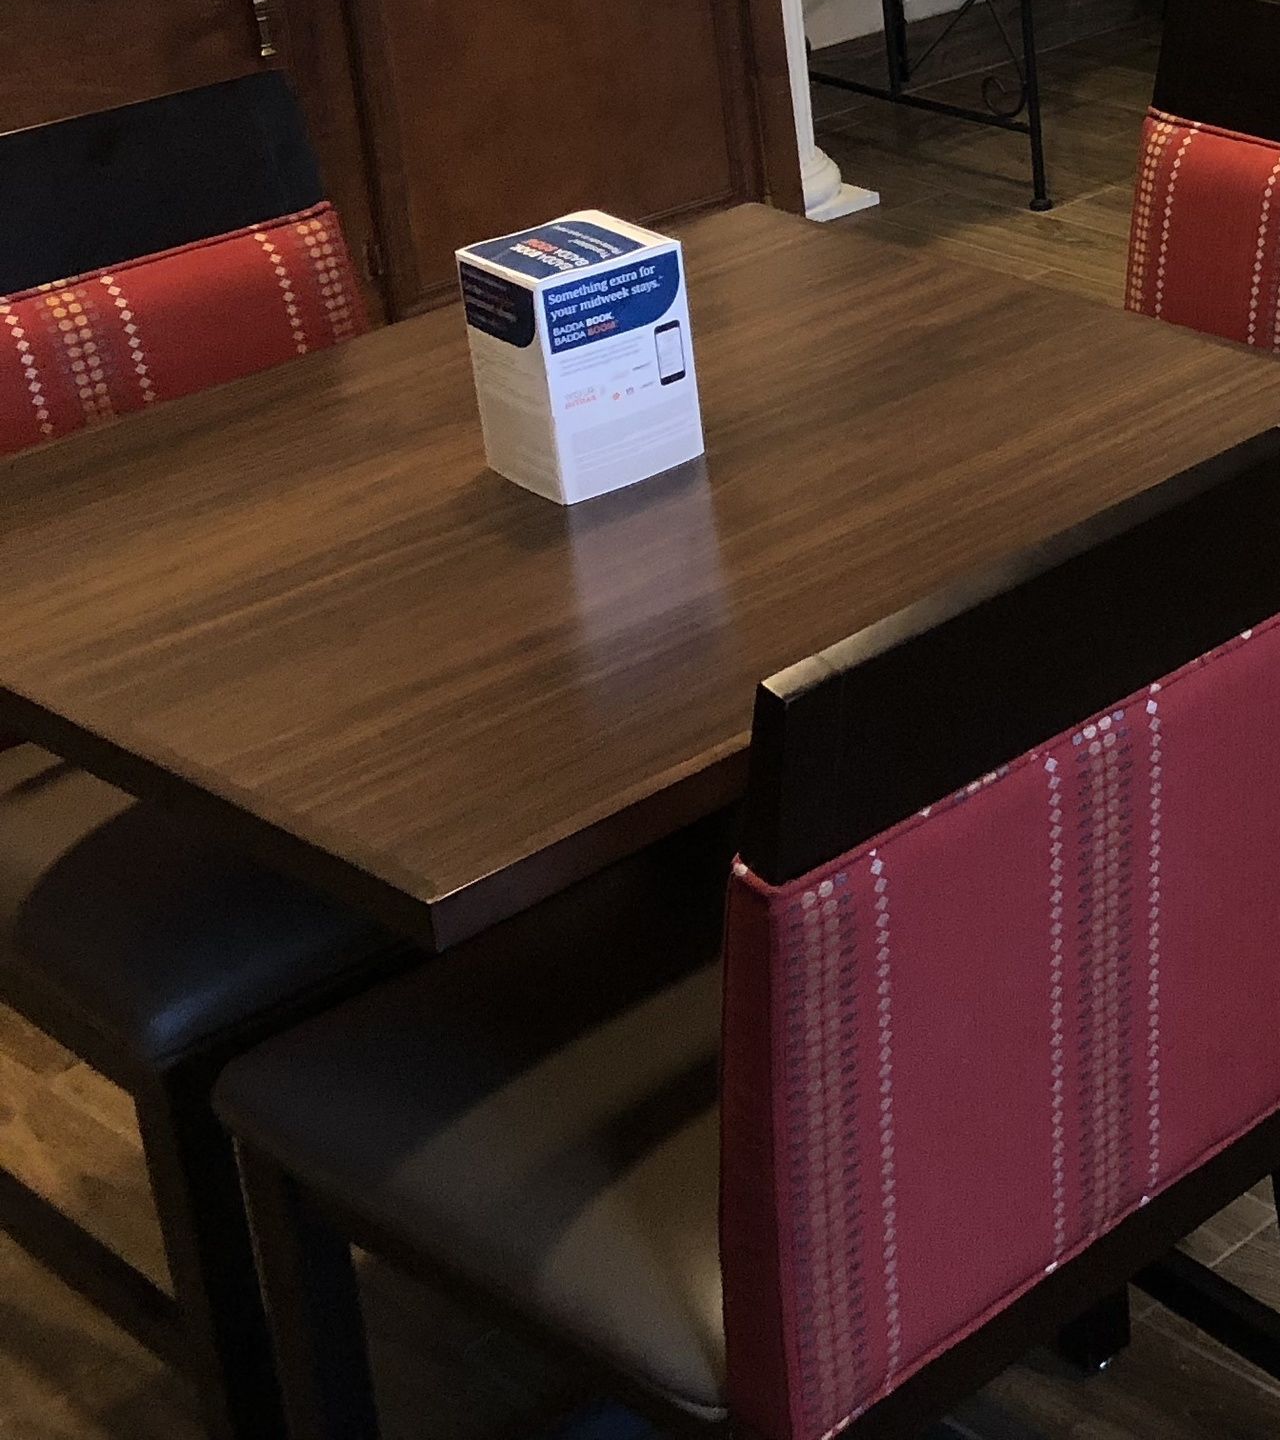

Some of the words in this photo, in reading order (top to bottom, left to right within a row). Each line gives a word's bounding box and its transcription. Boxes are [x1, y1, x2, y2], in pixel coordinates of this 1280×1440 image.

[547, 280, 609, 305] Something
[609, 271, 638, 287] extra
[638, 264, 656, 277] for
[549, 304, 578, 323] your
[580, 286, 631, 311] midweek
[552, 320, 585, 337] BADDA
[554, 330, 586, 347] BADDA
